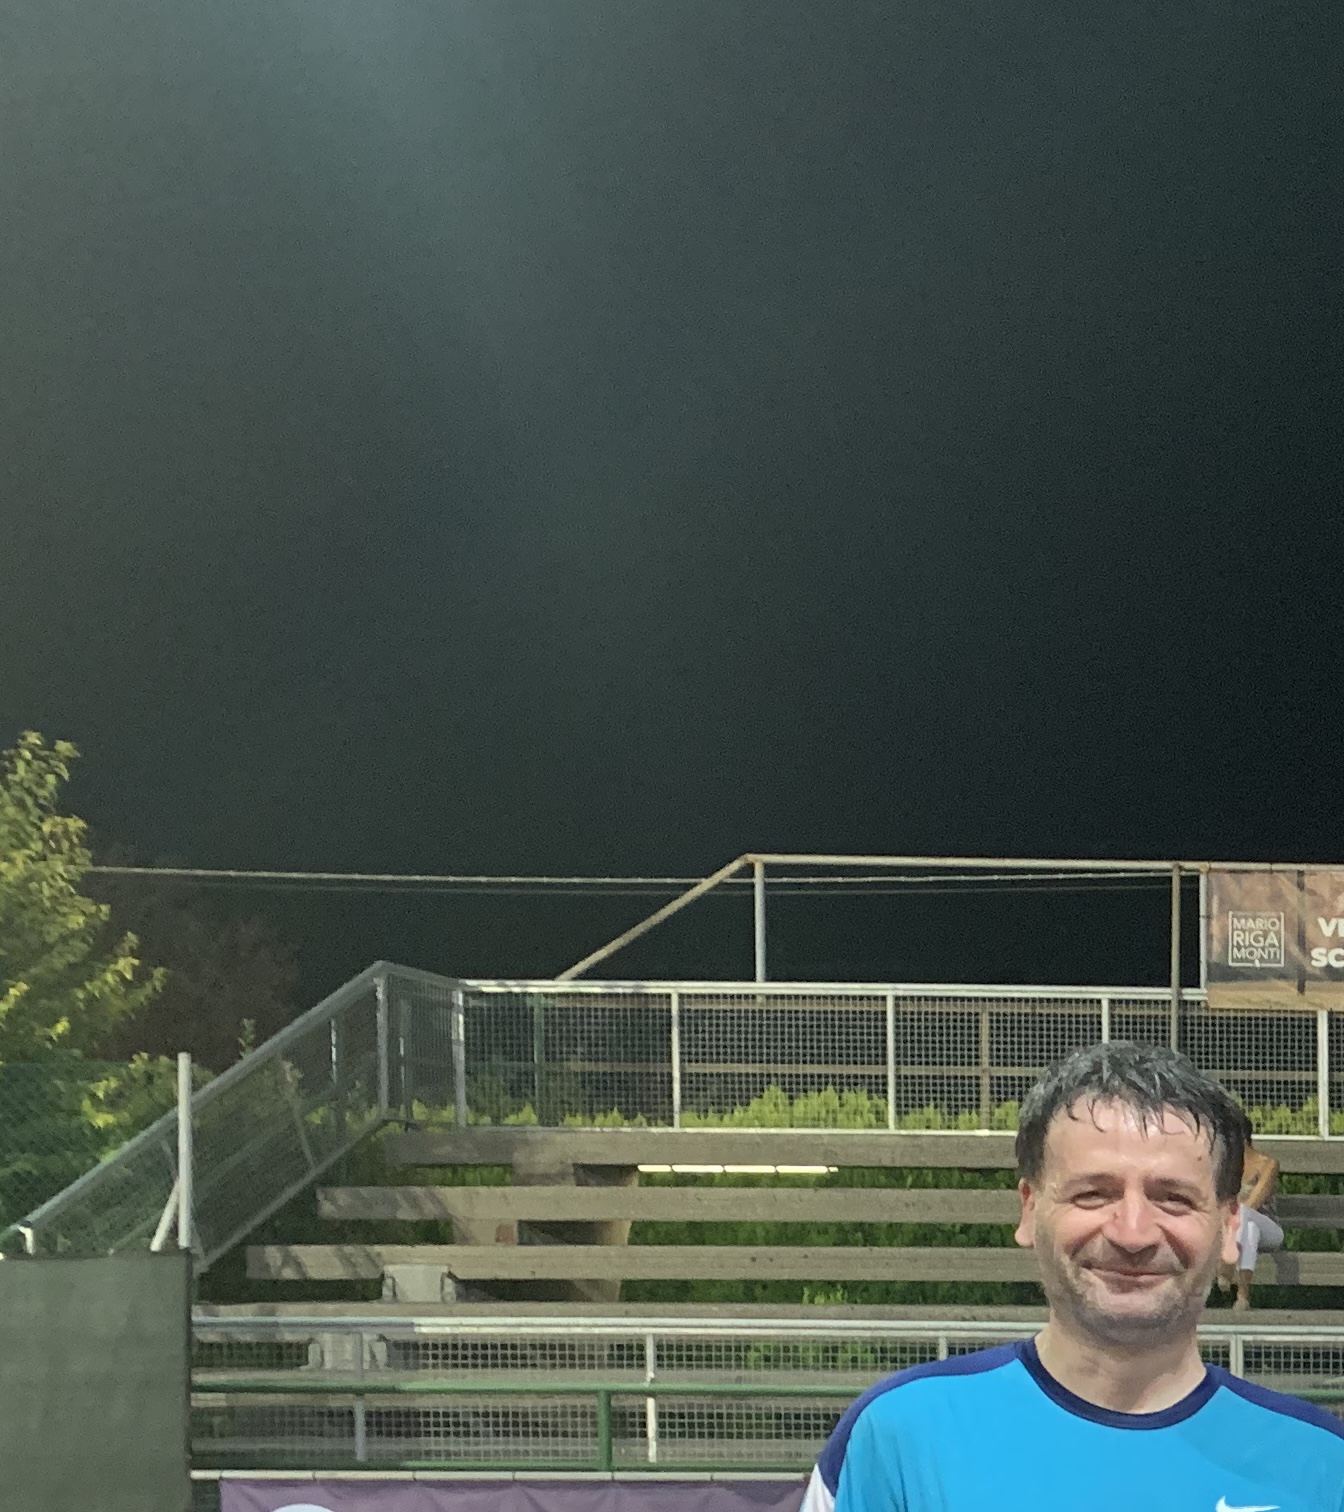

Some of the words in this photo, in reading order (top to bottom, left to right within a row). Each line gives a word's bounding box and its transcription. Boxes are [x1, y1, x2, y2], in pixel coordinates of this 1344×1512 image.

[1232, 917, 1280, 931] MARIO
[1233, 930, 1279, 947] RIGA
[1233, 947, 1280, 960] MONTI
